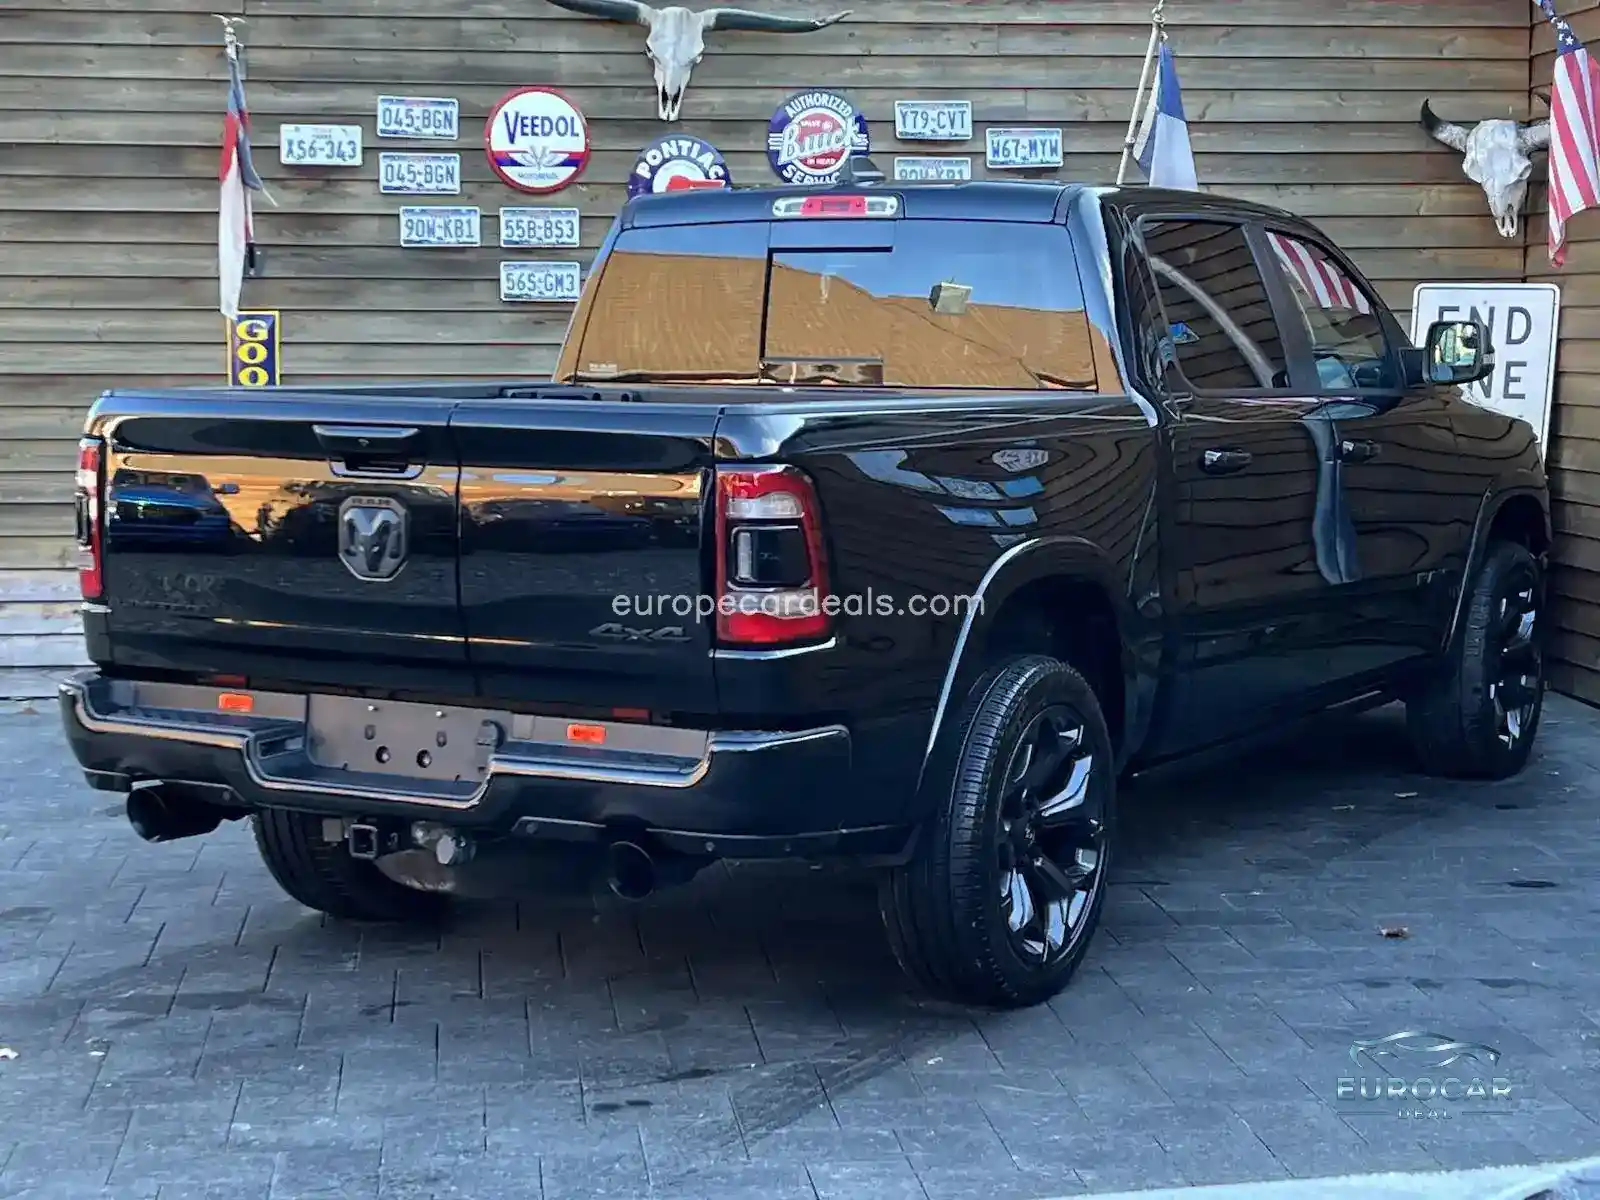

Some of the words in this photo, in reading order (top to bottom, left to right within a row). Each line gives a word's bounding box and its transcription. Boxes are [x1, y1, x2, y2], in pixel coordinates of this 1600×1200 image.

[784, 92, 853, 119] AUTHORIZED
[382, 107, 454, 130] 045-BGN
[504, 111, 580, 145] VEEDOL
[900, 109, 967, 130] Y79-CVT
[778, 115, 868, 166] Buick
[991, 138, 1059, 159] W67-MYW
[636, 139, 726, 180] PONTIAC
[385, 164, 456, 186] 045-BGN
[782, 164, 841, 185] SERVIC
[404, 218, 475, 239] 90W-KB1
[505, 272, 576, 293] 56S-GM3
[236, 319, 269, 387] GOO
